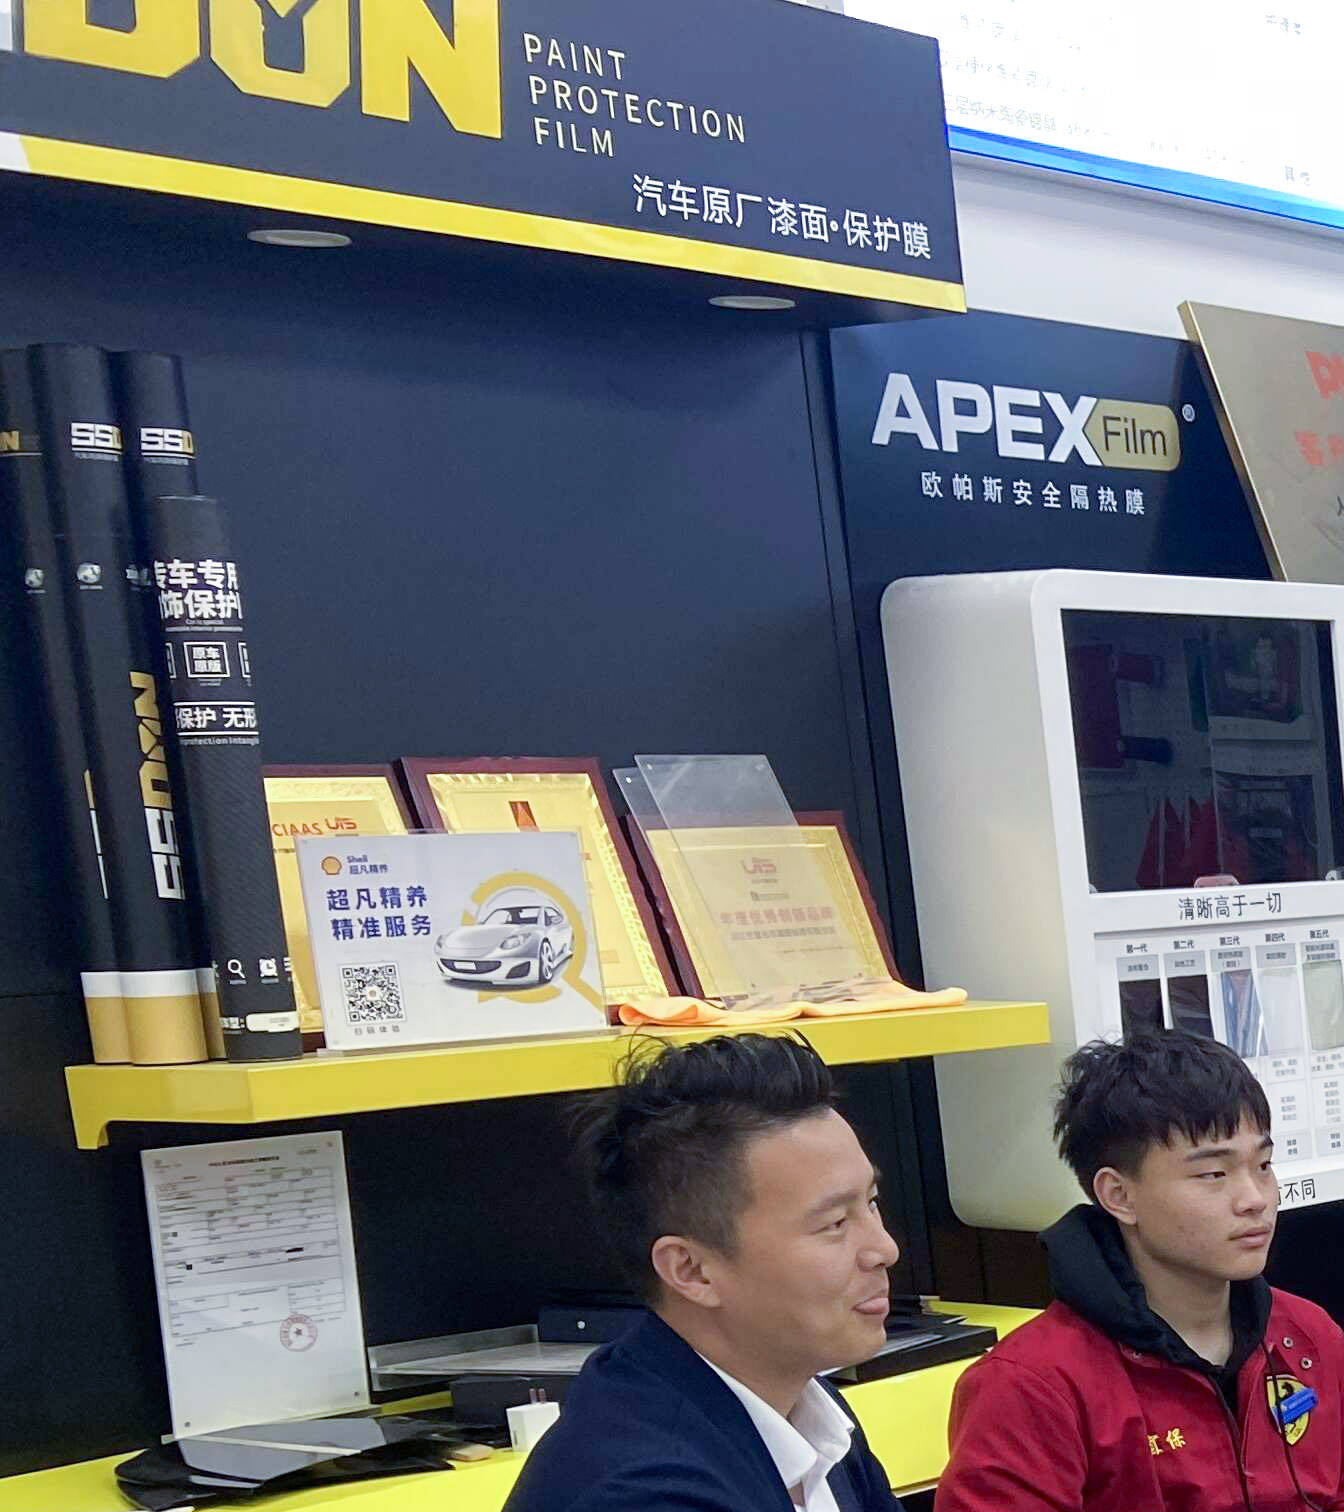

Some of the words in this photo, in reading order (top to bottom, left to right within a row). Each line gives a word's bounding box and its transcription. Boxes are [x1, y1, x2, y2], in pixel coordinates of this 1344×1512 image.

[522, 32, 628, 83] PAINT
[529, 75, 747, 145] PROTECTION
[533, 116, 617, 160] FILM
[872, 373, 1104, 467] APEX
[1100, 416, 1168, 458] Film
[920, 472, 1146, 517] 欧帕斯安全隔热膜
[326, 885, 428, 912] 超凡精养
[1178, 892, 1282, 921] 清晰高于一切
[330, 914, 432, 942] 精准服务
